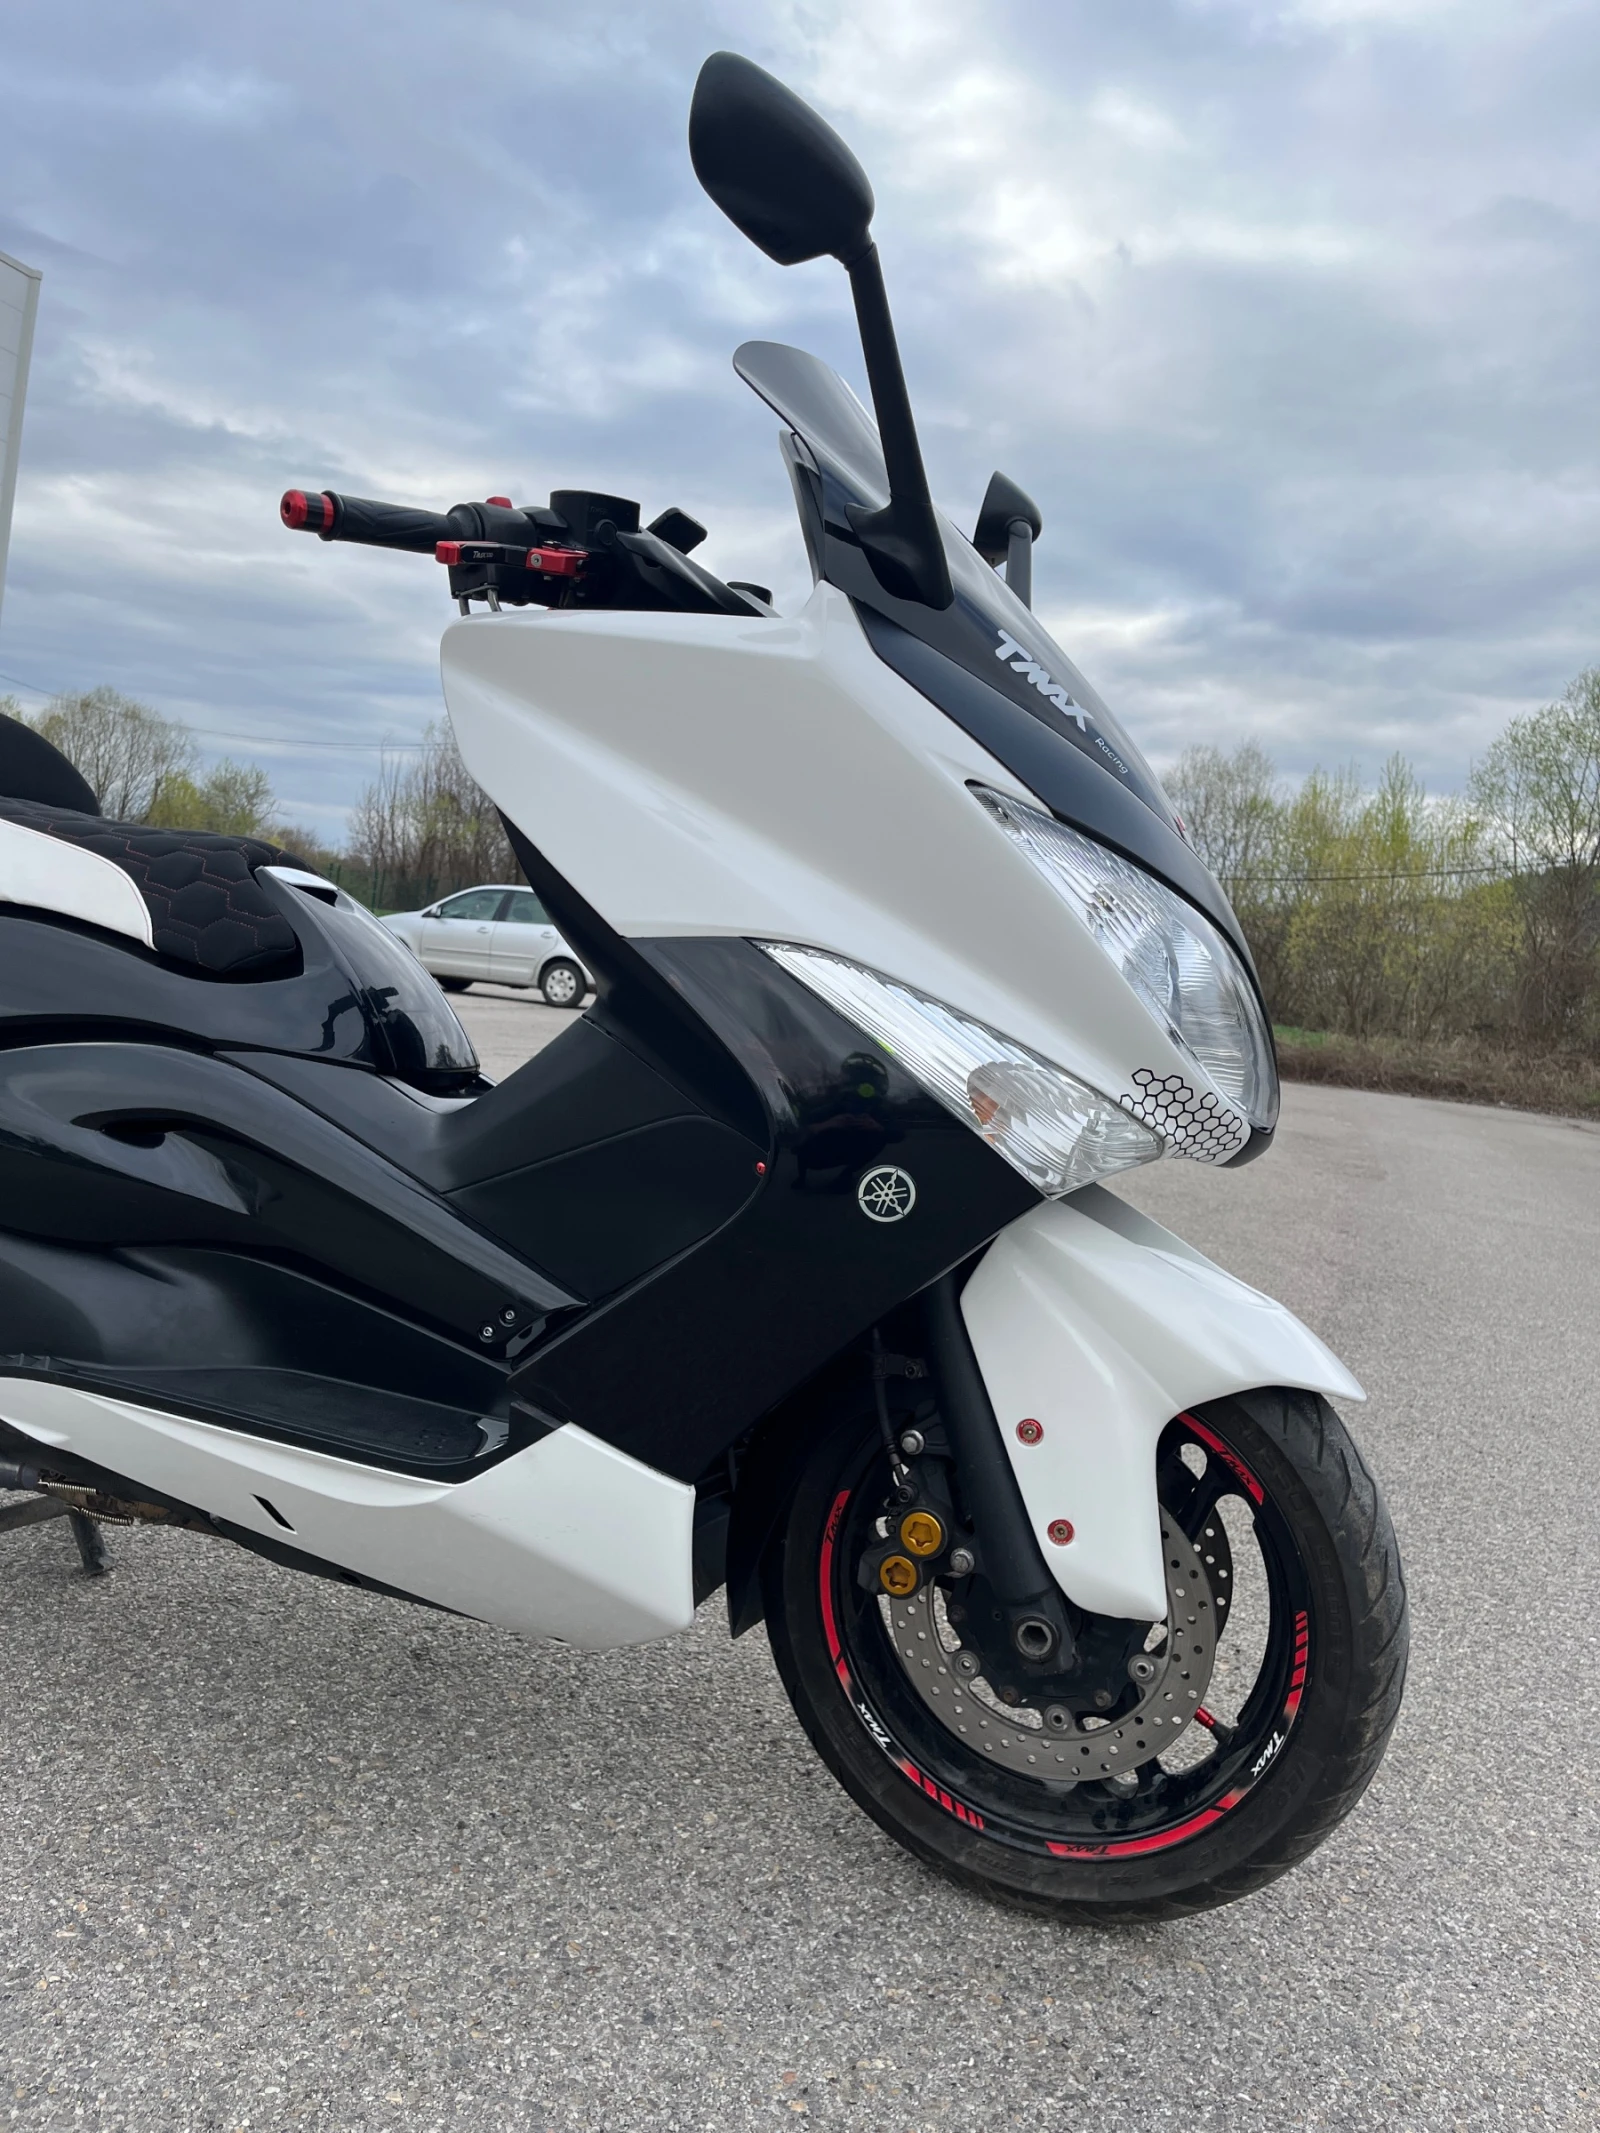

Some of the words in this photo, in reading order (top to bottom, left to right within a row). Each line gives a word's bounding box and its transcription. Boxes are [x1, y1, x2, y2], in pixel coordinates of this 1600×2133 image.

[994, 629, 1094, 732] TMAX
[1095, 737, 1129, 774] Racing
[857, 1703, 891, 1748] TMAX
[1251, 1731, 1284, 1777] TMAX
